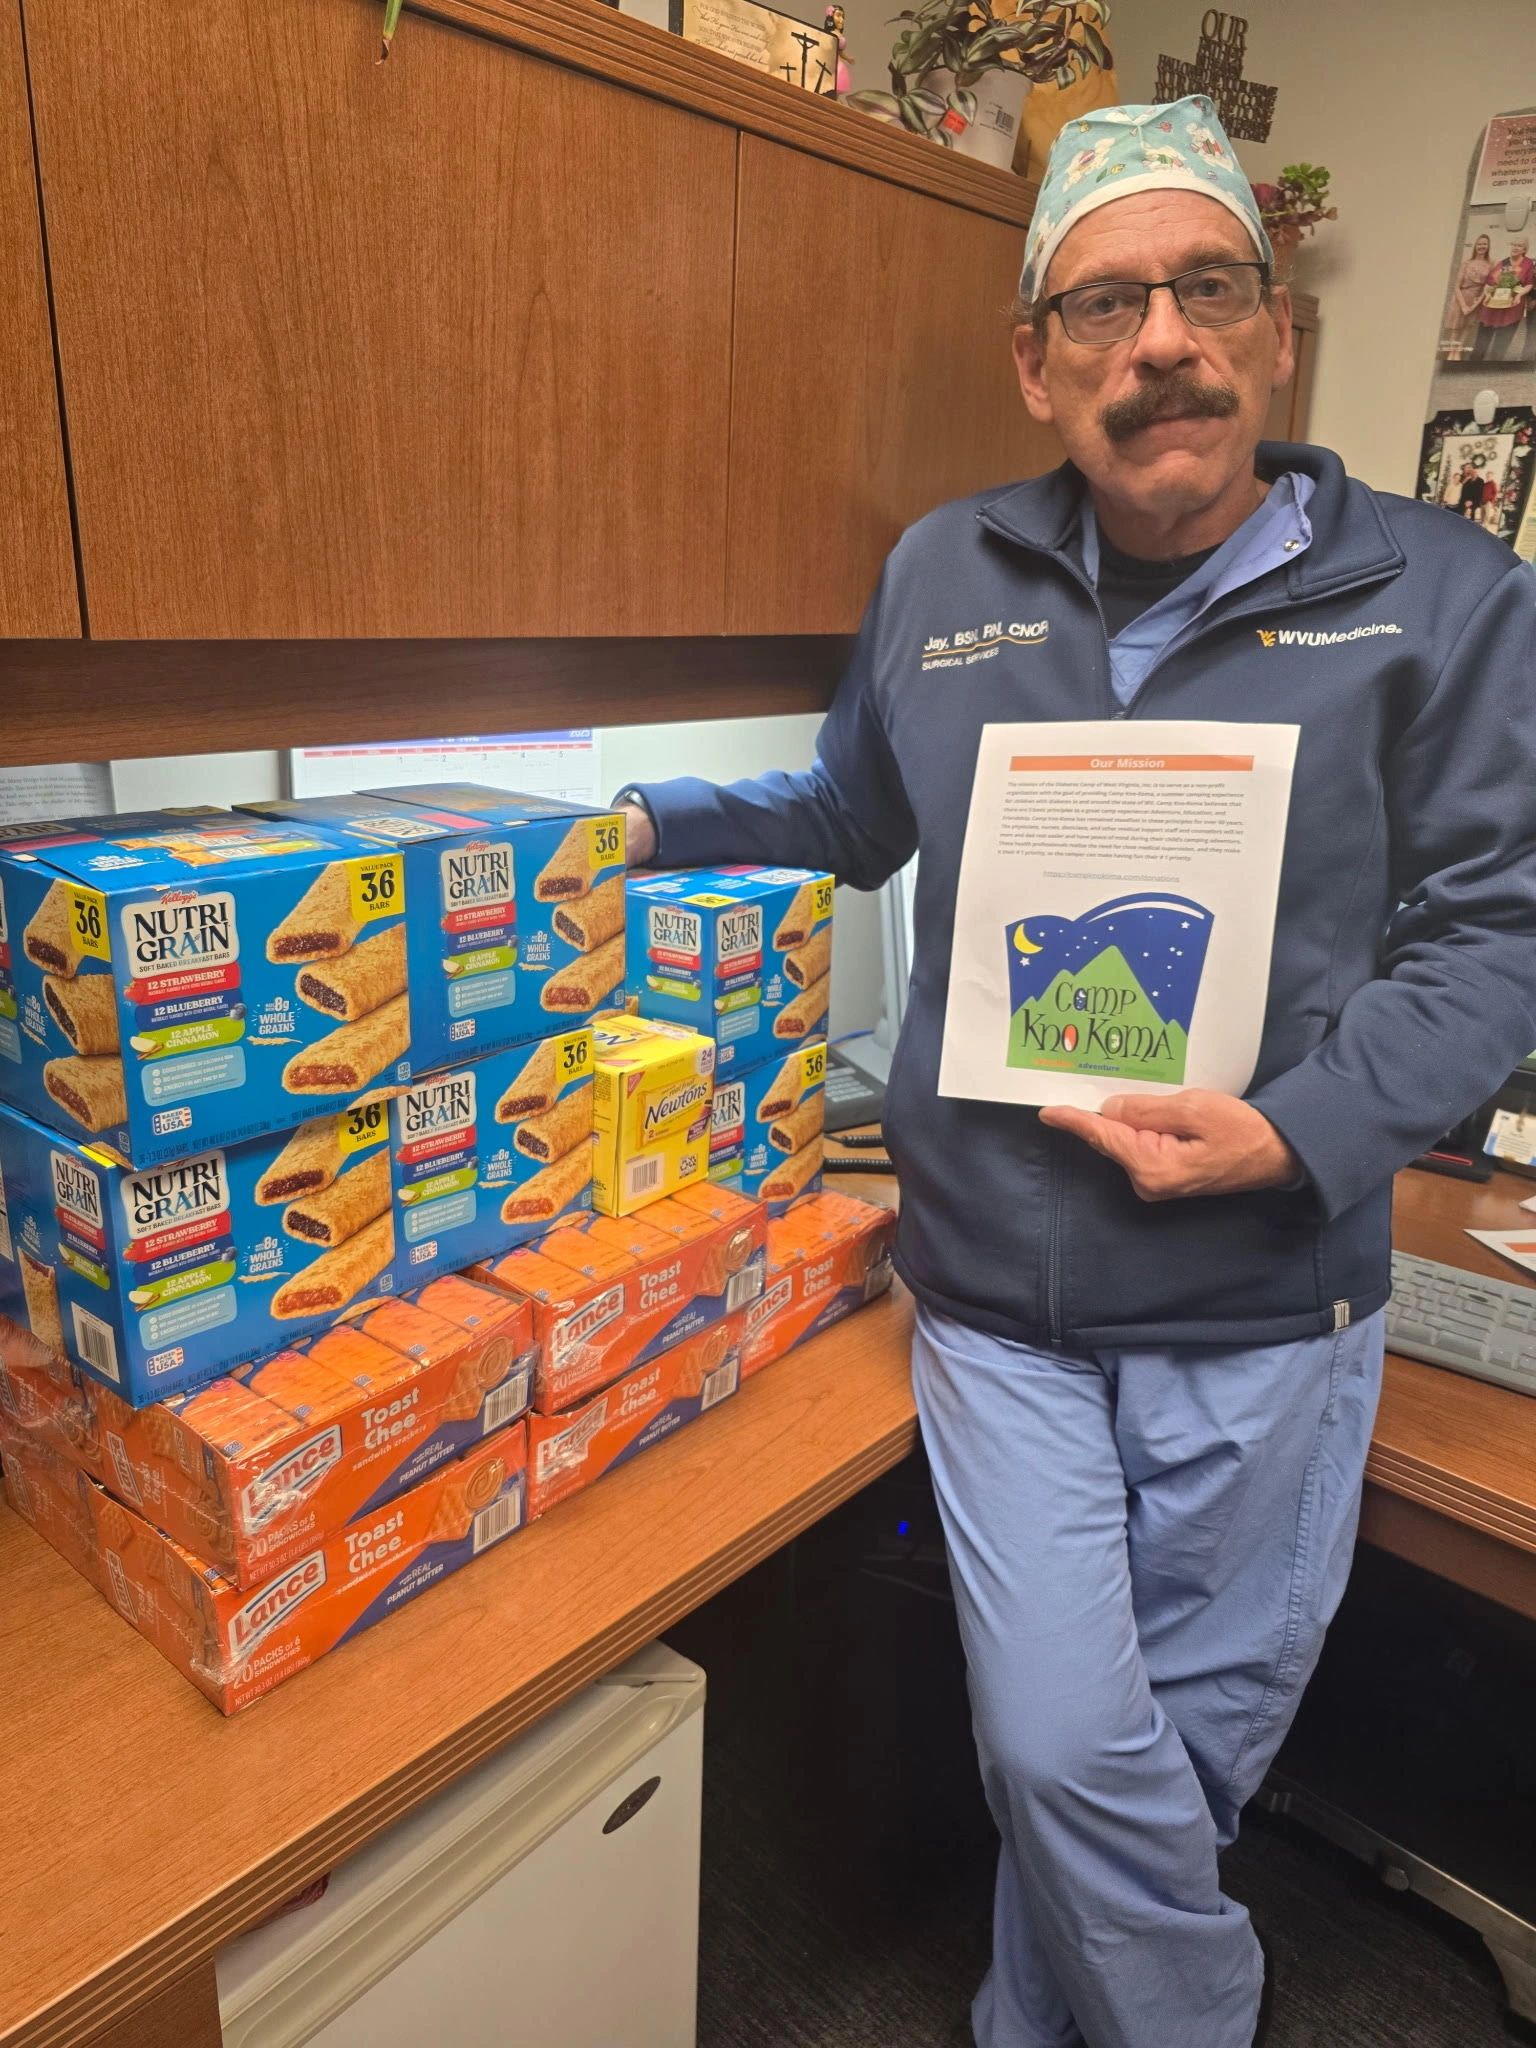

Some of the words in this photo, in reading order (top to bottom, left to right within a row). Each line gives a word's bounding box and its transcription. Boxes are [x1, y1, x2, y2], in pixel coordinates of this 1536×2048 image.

[1201, 9, 1249, 50] OUR
[922, 657, 963, 671] SURGICAL
[965, 647, 1000, 665] SERVICES
[1090, 758, 1114, 769] Our
[1117, 757, 1166, 769] Mission
[595, 827, 619, 853] 36
[448, 851, 509, 882] NUTRI
[600, 853, 616, 861] BARS
[360, 869, 395, 902] 36
[450, 866, 509, 899] GRAIN
[159, 891, 199, 905] Kellogg's
[369, 900, 391, 911] BARS
[816, 887, 832, 909] 36
[74, 900, 101, 938] 36
[134, 902, 229, 942] NUTRI
[464, 907, 506, 921] STRAWBERRY
[653, 912, 697, 931] NUTRI
[721, 911, 760, 938] NUTRI
[82, 936, 99, 949] BARS
[136, 922, 231, 963] GRAIN
[467, 928, 505, 942] BLUEBERRY
[653, 929, 697, 947] GRAIN
[721, 928, 760, 952] GRAIN
[526, 952, 550, 961] GRAINS
[527, 943, 550, 953] WHOLE
[139, 964, 156, 973] SOFT
[156, 960, 178, 970] BAKED
[178, 954, 213, 967] BREAKFAST
[214, 951, 231, 961] BARS
[147, 980, 159, 991] 12
[159, 969, 225, 989] STRAWBERRY
[25, 1005, 45, 1027] WHOLE
[154, 1005, 166, 1016] 12
[167, 995, 224, 1014] BLUEBERRY
[258, 1023, 295, 1035] GRAINS
[259, 1012, 295, 1025] WHOLE
[166, 1031, 220, 1049] CINNAMON
[171, 1029, 182, 1040] 12
[182, 1024, 215, 1038] APPLE
[456, 1029, 471, 1038] USA
[1021, 1008, 1079, 1053] Kno
[563, 1041, 588, 1069] 36
[702, 1049, 713, 1061] 24
[806, 1054, 823, 1077] 36
[568, 1065, 583, 1076] BARS
[1078, 1062, 1120, 1072] adventure
[406, 1079, 470, 1117] NUTRI
[644, 1082, 708, 1129] Newtons
[714, 1089, 741, 1110] UTRI
[347, 1103, 382, 1135] 36
[406, 1095, 470, 1132] GRAIN
[712, 1102, 740, 1126] RAIN
[162, 1119, 185, 1132] USA
[356, 1130, 376, 1143] BARS
[420, 1131, 467, 1150] STRAWBERRY
[424, 1152, 464, 1171] BLUEBERRY
[487, 1159, 513, 1171] WHOLE
[55, 1158, 96, 1195] NUTRI
[131, 1158, 218, 1207] NUTRI
[487, 1168, 513, 1180] GRAINS
[57, 1180, 98, 1217] GRAIN
[134, 1176, 221, 1225] GRAIN
[136, 1225, 152, 1235] SOFT
[153, 1218, 173, 1229] BAKED
[173, 1208, 206, 1224] BREAKFAST
[206, 1203, 222, 1213] BARS
[145, 1238, 156, 1250] 12
[156, 1219, 218, 1247] STRAWBERRY
[151, 1259, 162, 1271] 12
[162, 1243, 216, 1267] BLUEBERRY
[249, 1258, 284, 1274] GRAINS
[250, 1248, 283, 1264] WHOLE
[417, 1252, 432, 1262] USA
[177, 1269, 206, 1286] APPLE
[639, 1261, 682, 1291] Toast
[803, 1255, 834, 1282] Toast
[162, 1274, 212, 1297] CINNAMON
[639, 1282, 678, 1309] Chee
[803, 1275, 832, 1297] Chee
[662, 1328, 684, 1344] PEANUT
[684, 1316, 705, 1332] BUTTER
[156, 1359, 177, 1372] USA
[622, 1367, 661, 1400] Toast
[361, 1386, 420, 1430] Toast
[619, 1388, 658, 1416] Chee
[364, 1413, 417, 1449] Chee
[352, 1445, 393, 1472] sandwich
[424, 1441, 444, 1456] REAL
[400, 1461, 428, 1484] PEANUT
[429, 1443, 455, 1465] BUTTER
[344, 1510, 404, 1555] Toast
[247, 1537, 268, 1564] 20
[349, 1535, 402, 1574] Chee
[412, 1561, 432, 1577] REAL
[386, 1581, 416, 1605] PEANUT
[416, 1564, 444, 1586] BUTTER
[234, 1562, 320, 1646] Lance
[254, 1645, 284, 1671] PACKS
[294, 1635, 301, 1645] 6
